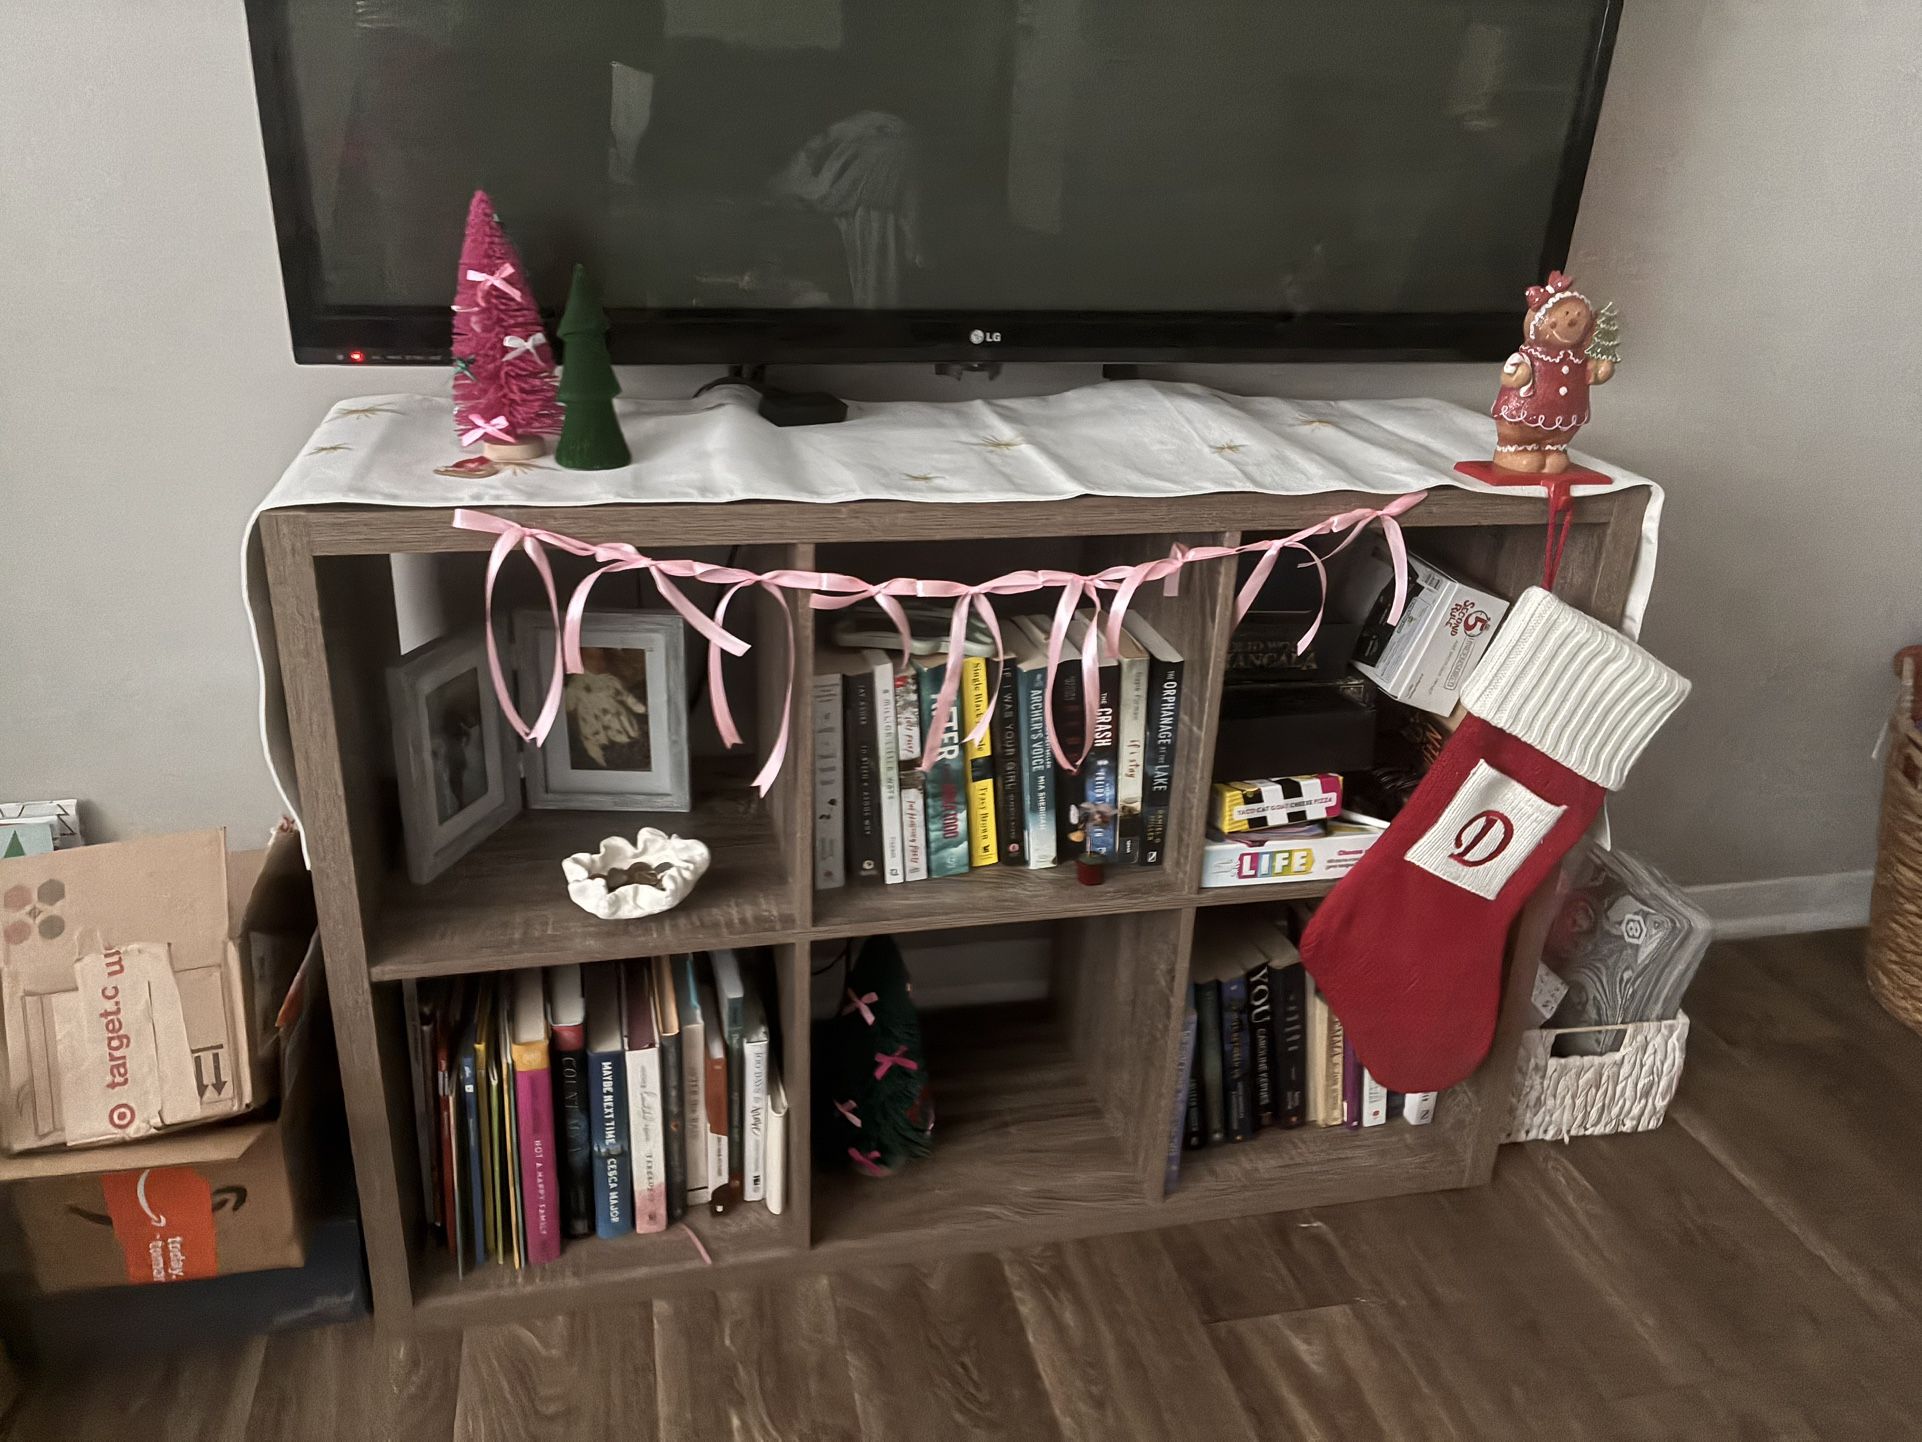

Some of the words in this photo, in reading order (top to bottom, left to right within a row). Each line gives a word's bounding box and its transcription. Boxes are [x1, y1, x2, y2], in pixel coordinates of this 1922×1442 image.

[985, 332, 1001, 342] LG
[1445, 603, 1462, 628] RULE
[1450, 599, 1475, 636] SECOND
[972, 662, 983, 691] Single
[1166, 670, 1176, 680] THE
[930, 693, 960, 763] TER
[1030, 689, 1044, 740] ARCHER'S
[1094, 707, 1113, 747] CRASH
[1157, 681, 1178, 745] ORPHANAGE
[1032, 741, 1045, 772] VOICE
[1125, 759, 1140, 778] stay
[1037, 775, 1046, 790] MIA
[1151, 764, 1171, 792] LAKE
[1448, 809, 1514, 868] D
[1241, 851, 1309, 878] LIFE
[1249, 965, 1271, 1024] YOU
[601, 1061, 614, 1094] MAYBE
[603, 1095, 615, 1119] NEXT
[604, 1120, 617, 1146] TIME
[609, 1191, 621, 1223] MAJOR
